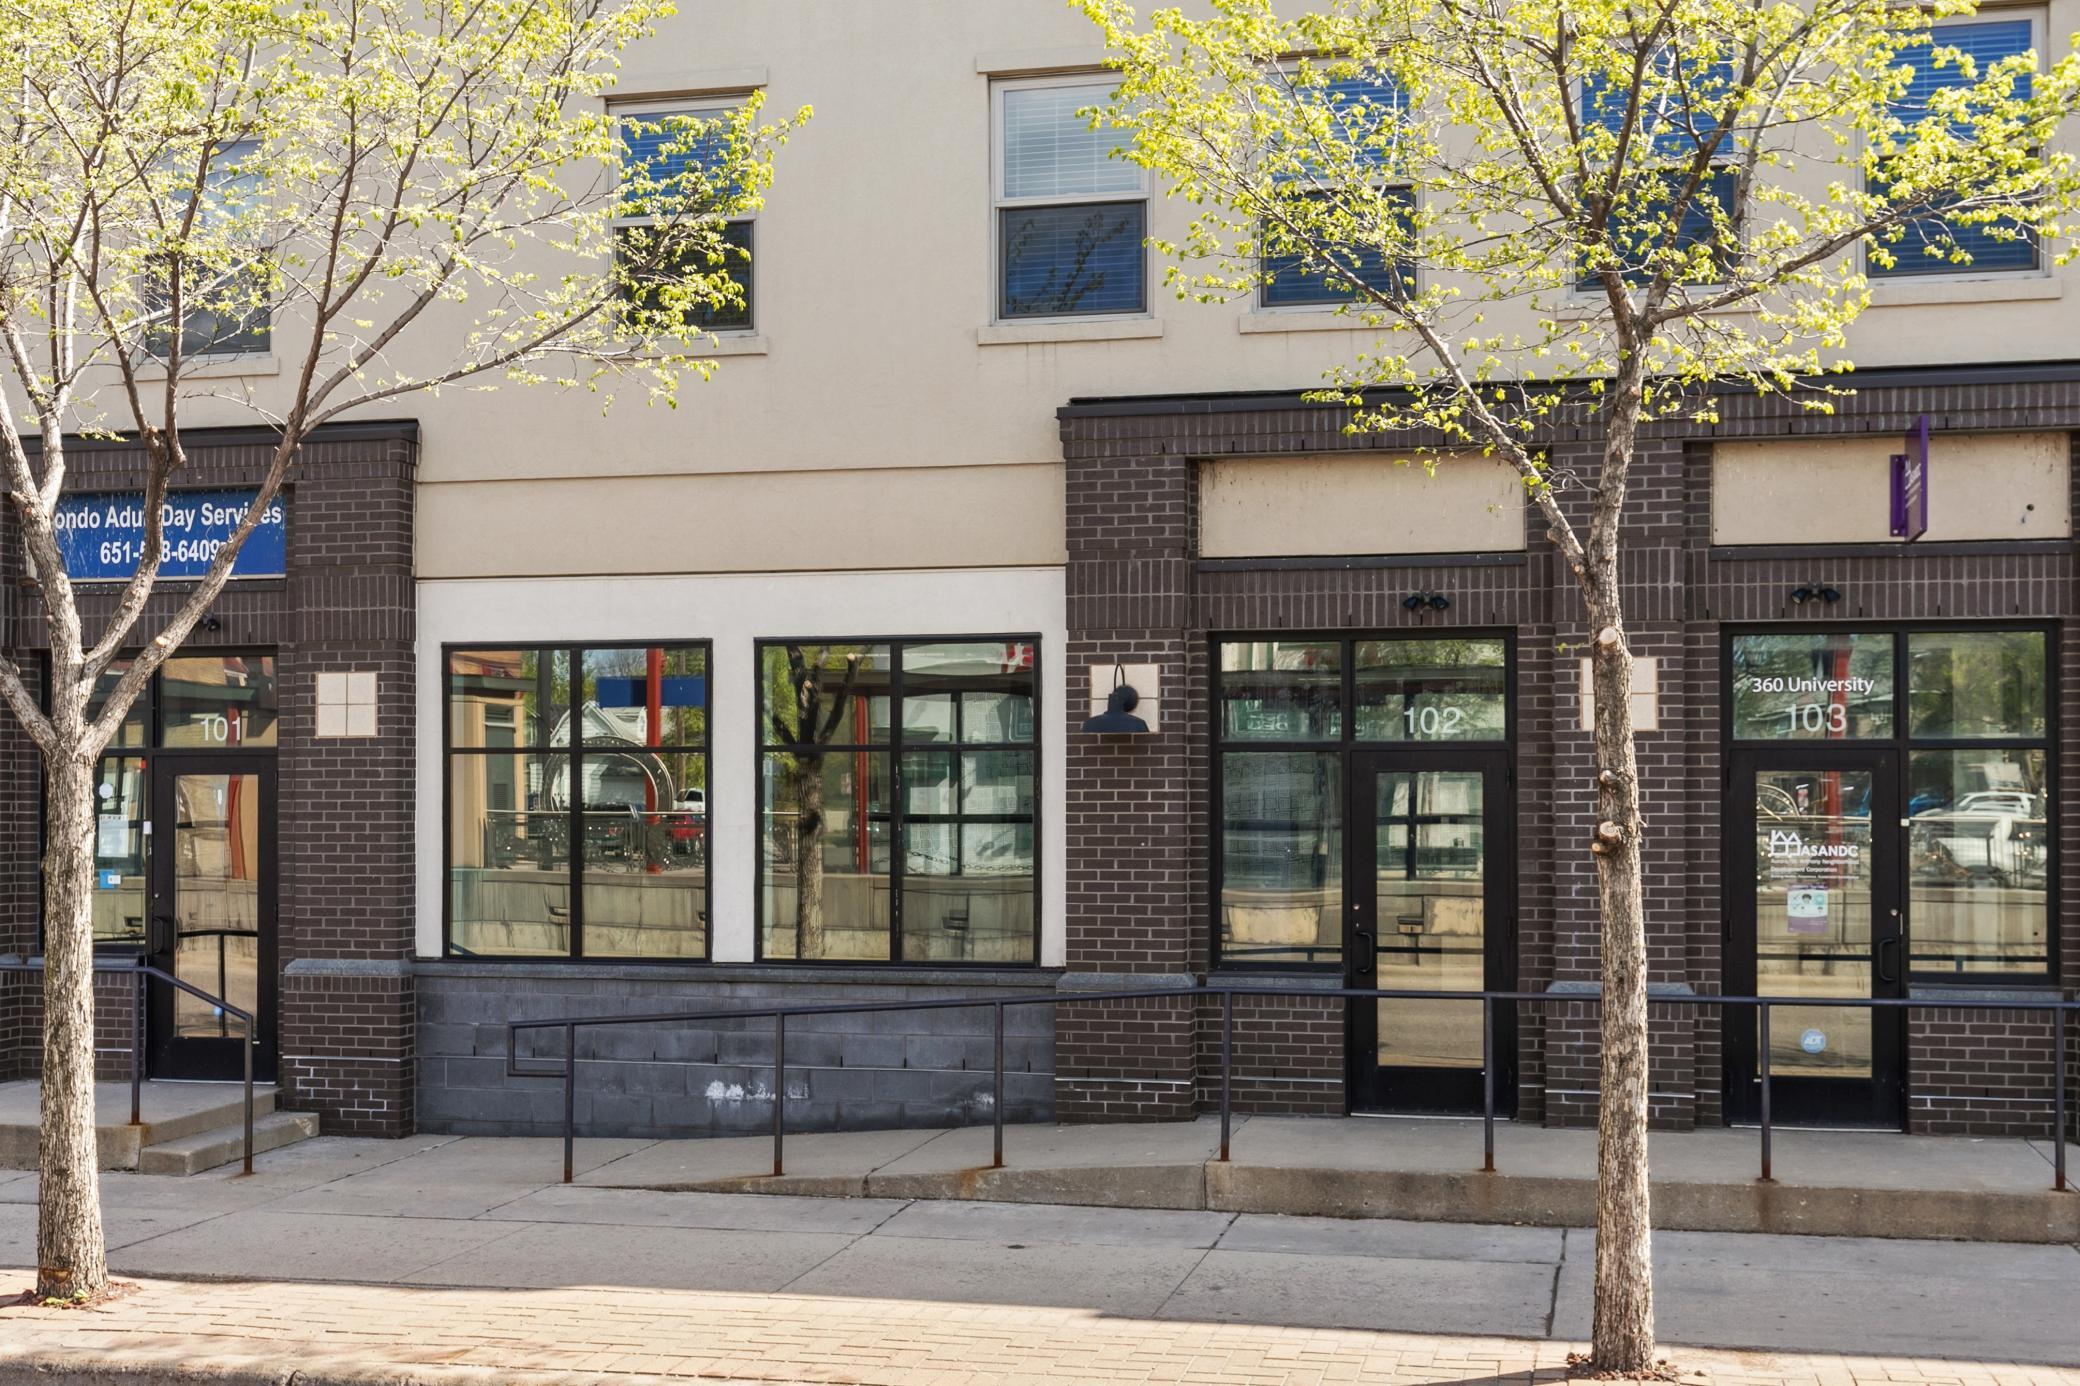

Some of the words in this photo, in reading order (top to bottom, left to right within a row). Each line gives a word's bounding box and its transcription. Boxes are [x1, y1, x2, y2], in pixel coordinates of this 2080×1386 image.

[55, 506, 101, 529] ondo
[104, 505, 147, 528] Adu
[162, 504, 195, 532] Day
[201, 501, 282, 526] Servies
[100, 539, 221, 564] 651-8-6409
[1752, 677, 1784, 693] 360
[1788, 676, 1875, 695] University
[200, 716, 241, 741] 101
[1403, 706, 1461, 734] 102
[1787, 703, 1848, 732] 103
[1800, 845, 1859, 857] ASANDC
